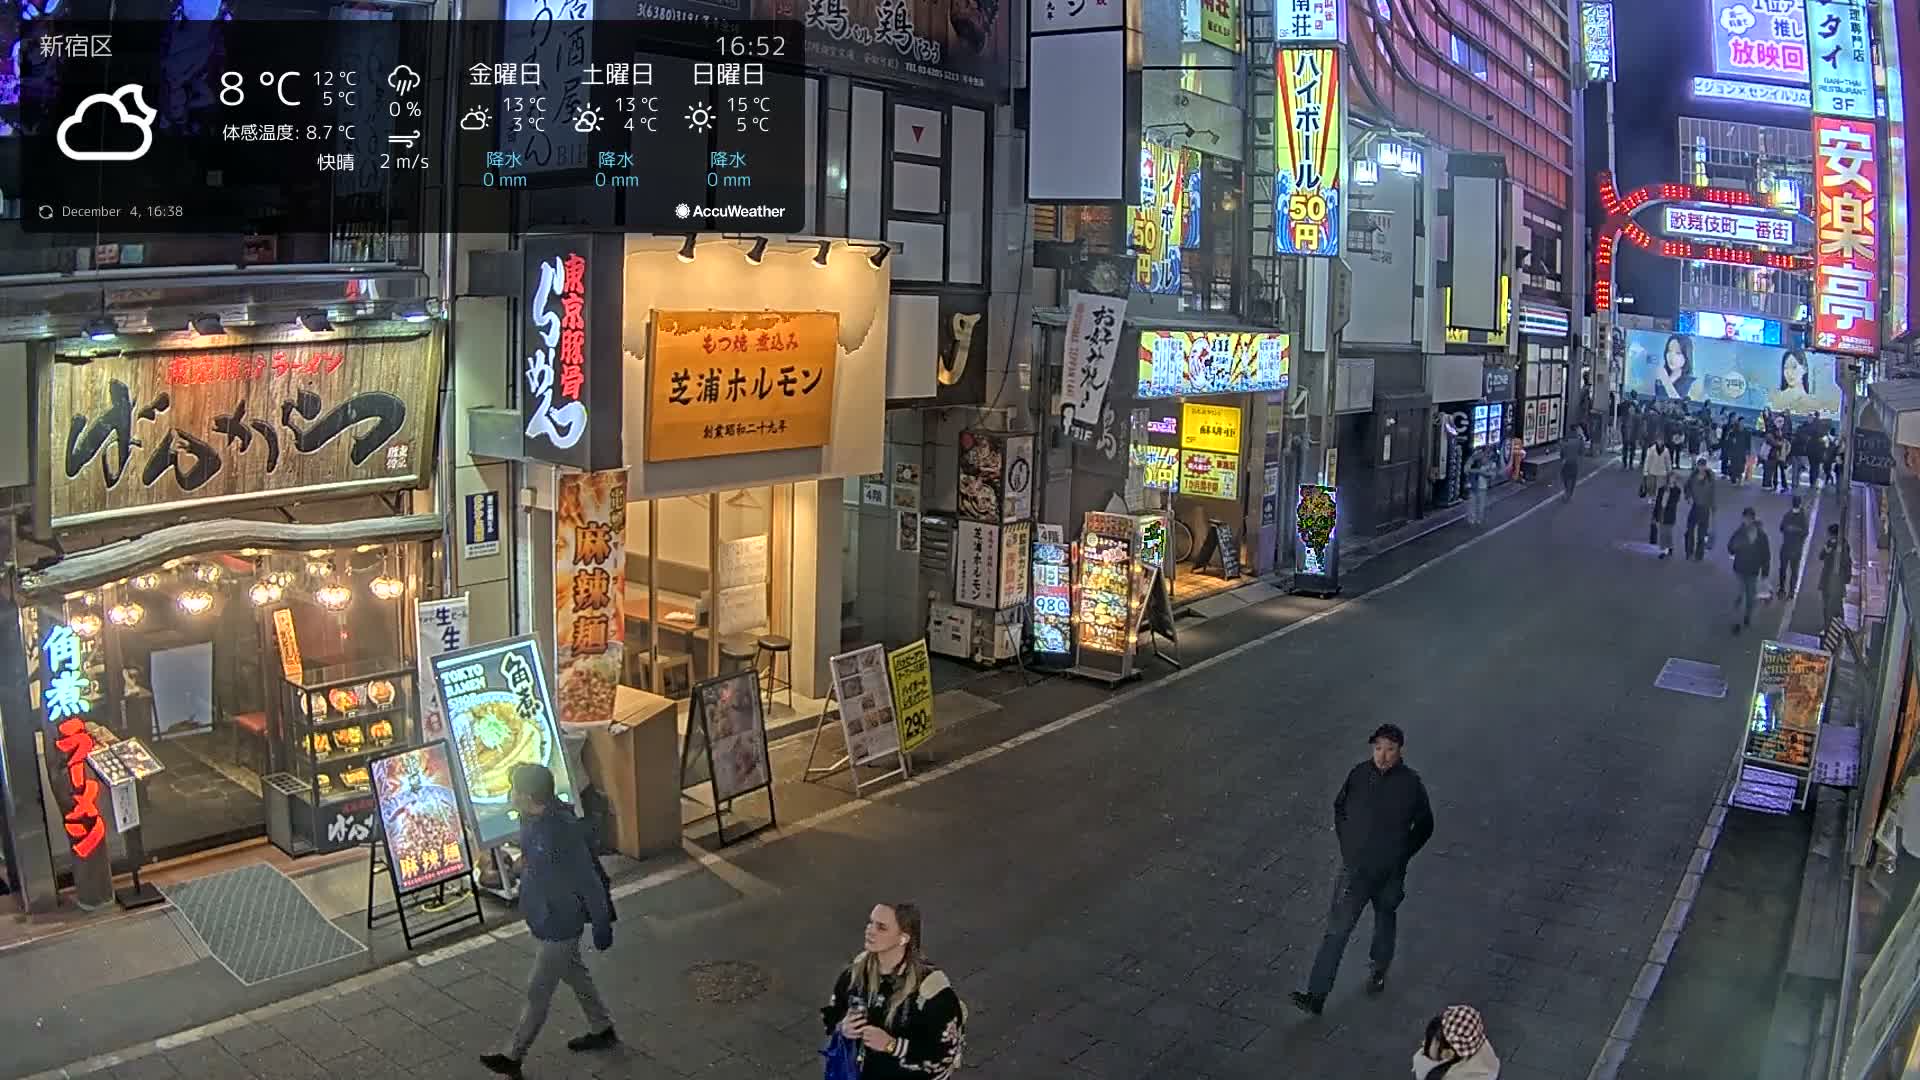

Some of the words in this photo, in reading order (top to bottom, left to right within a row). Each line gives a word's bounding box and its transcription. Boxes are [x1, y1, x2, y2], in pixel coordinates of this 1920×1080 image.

[1773, 17, 1804, 38] 推し
[1731, 38, 1804, 71] 放映回
[1588, 62, 1610, 78] 7F
[1832, 97, 1855, 110] 3F
[1295, 54, 1321, 188] ハイボール
[1669, 211, 1789, 241] 歌舞伎町一番街
[1817, 125, 1875, 330] 安楽亭
[560, 253, 586, 400] 東京豚骨
[1817, 332, 1837, 347] 2F
[702, 334, 747, 354] もつ焼
[755, 331, 800, 353] 煮込み
[668, 366, 824, 406] 芝浦ホルモン
[65, 378, 406, 491] ばんから
[572, 520, 613, 657] 麻辣麺
[1036, 597, 1067, 612] 980
[441, 664, 484, 684] TOKYO
[444, 678, 486, 698] RAMEN
[504, 653, 543, 719] 角煮
